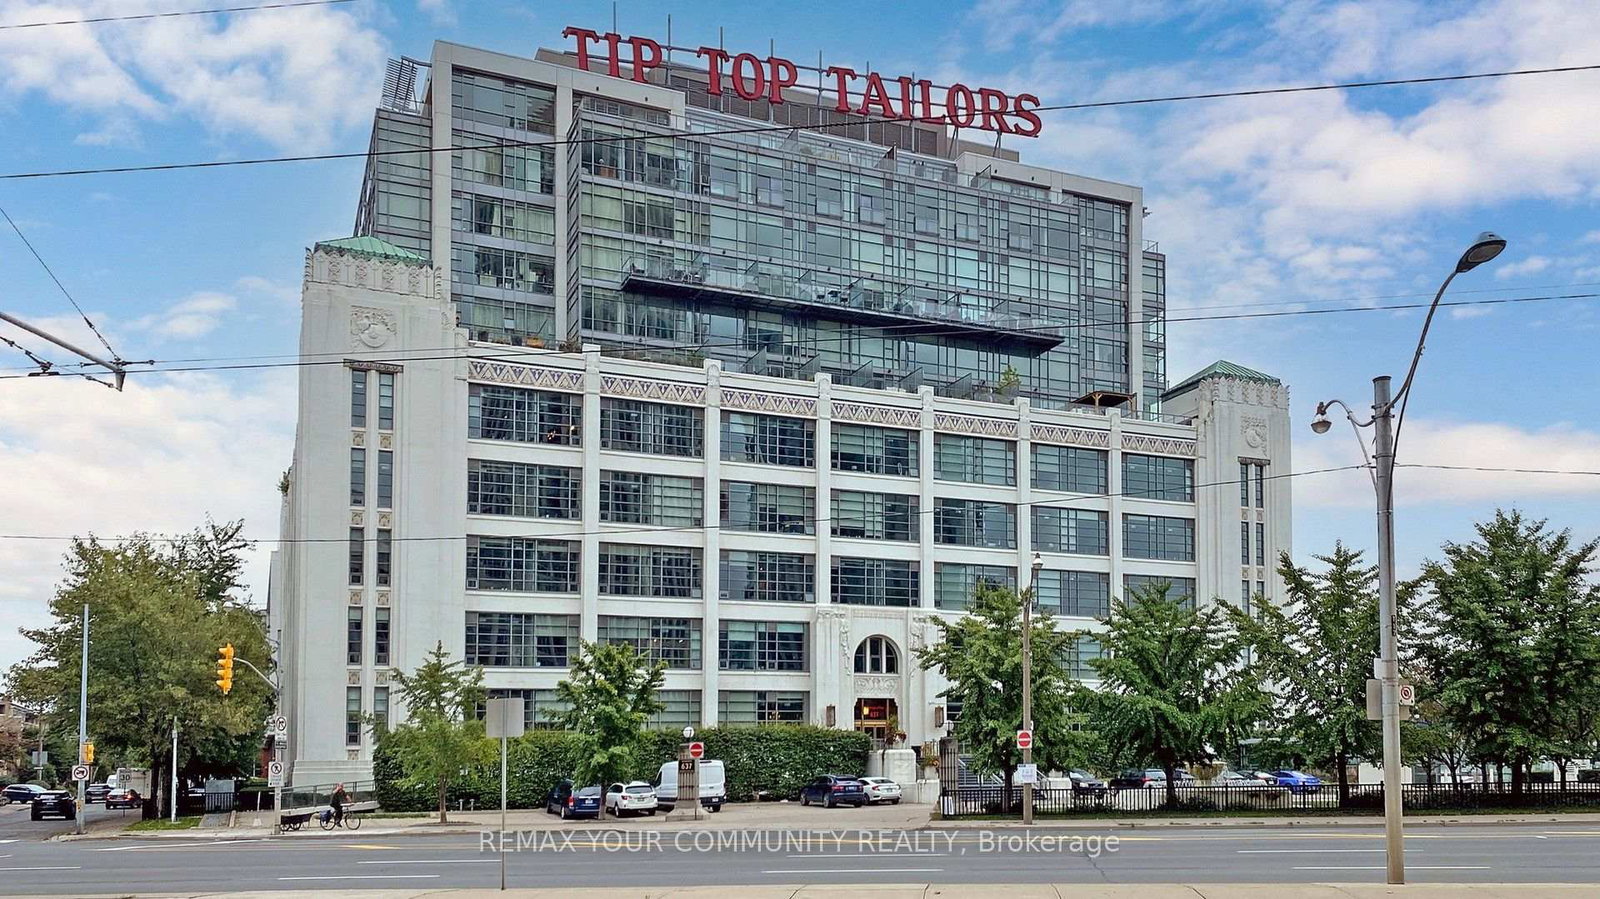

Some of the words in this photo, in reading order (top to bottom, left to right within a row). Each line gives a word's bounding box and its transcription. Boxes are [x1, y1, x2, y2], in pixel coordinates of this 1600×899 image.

[562, 26, 662, 83] TIP
[697, 46, 798, 105] TOP
[826, 66, 1043, 138] TAILORS
[680, 762, 693, 770] 637
